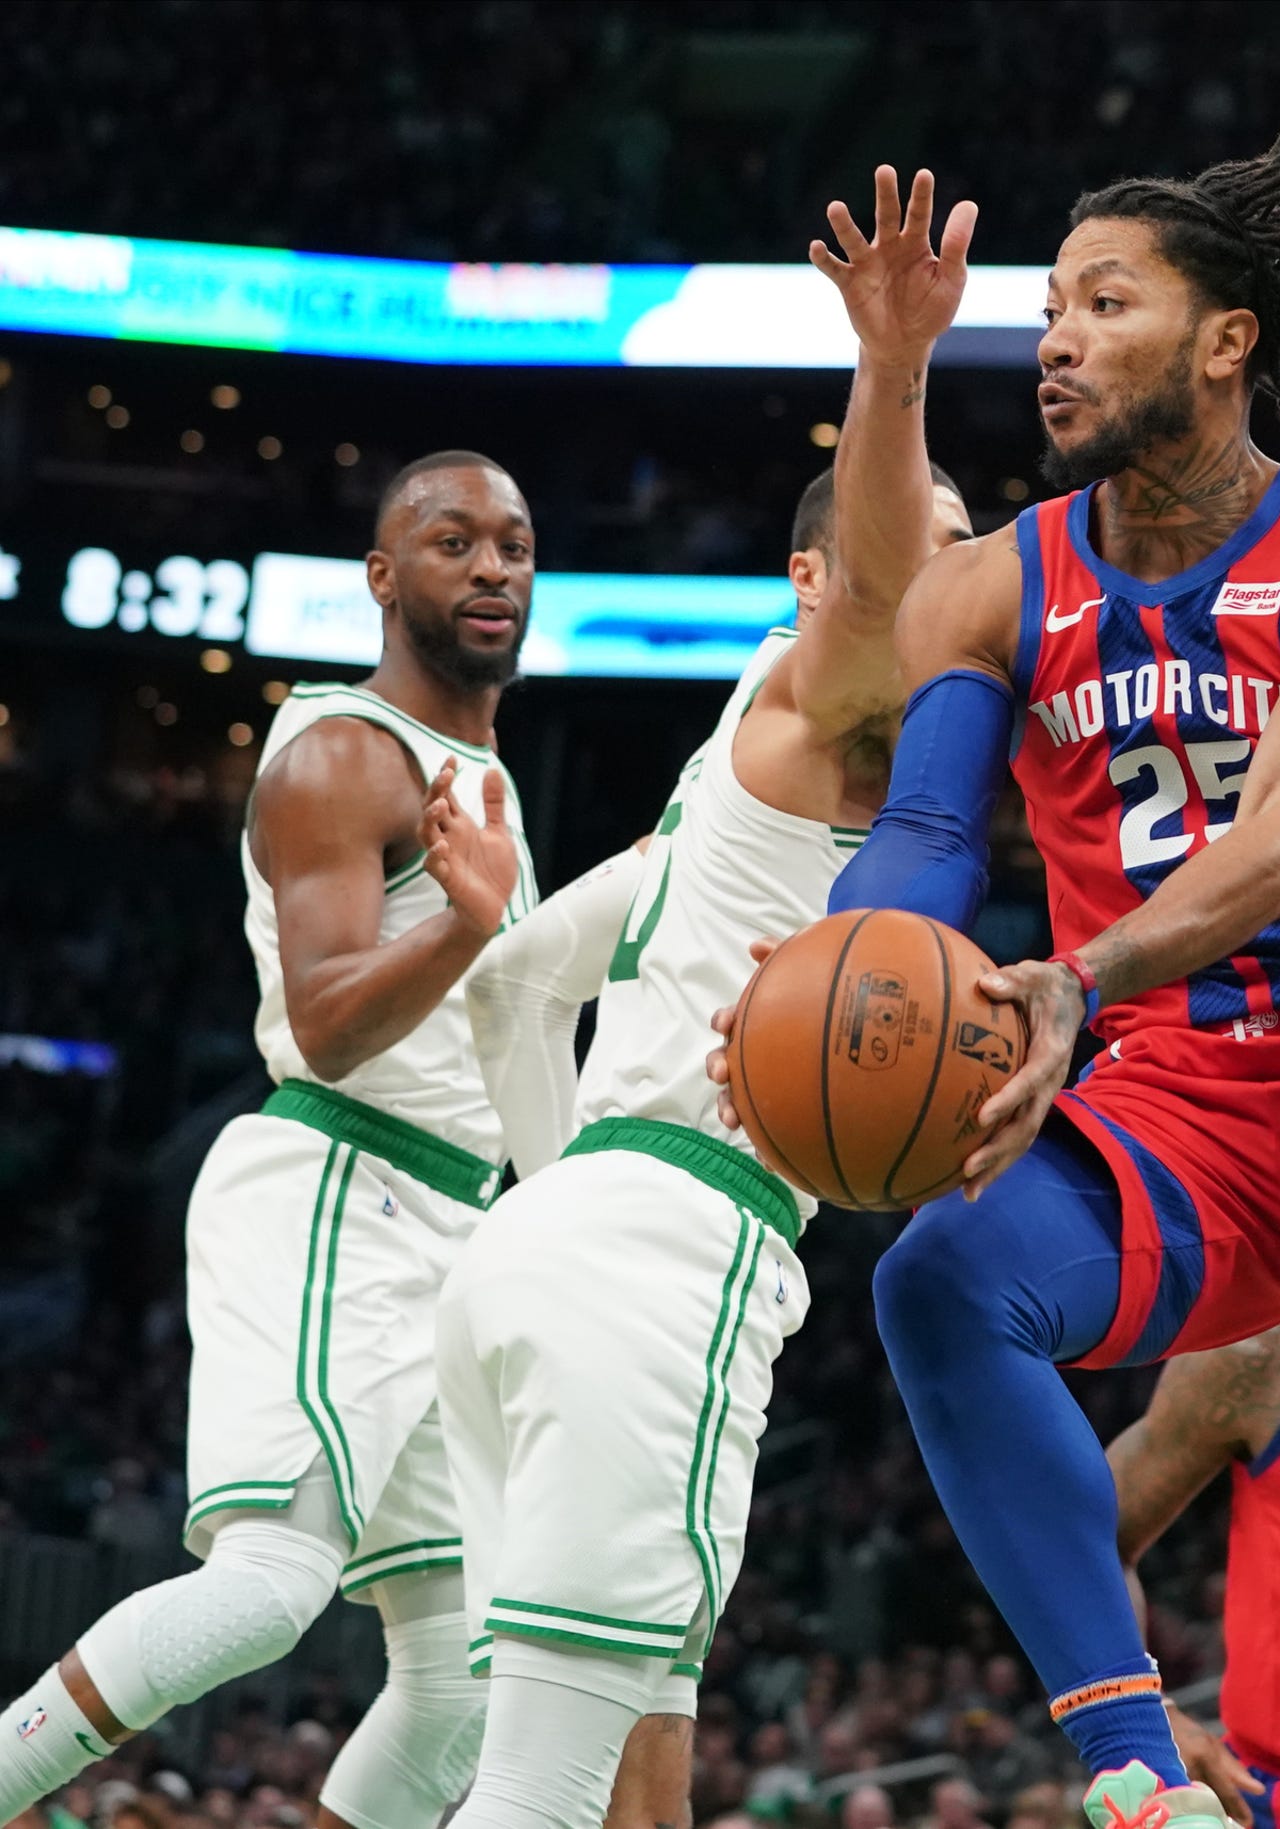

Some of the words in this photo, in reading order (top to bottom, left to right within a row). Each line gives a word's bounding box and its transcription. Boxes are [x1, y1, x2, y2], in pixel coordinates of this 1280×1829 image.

[62, 547, 250, 642] 8:32
[1256, 602, 1276, 610] Bank
[1028, 659, 1193, 748] MOTOR
[1108, 739, 1250, 869] 25
